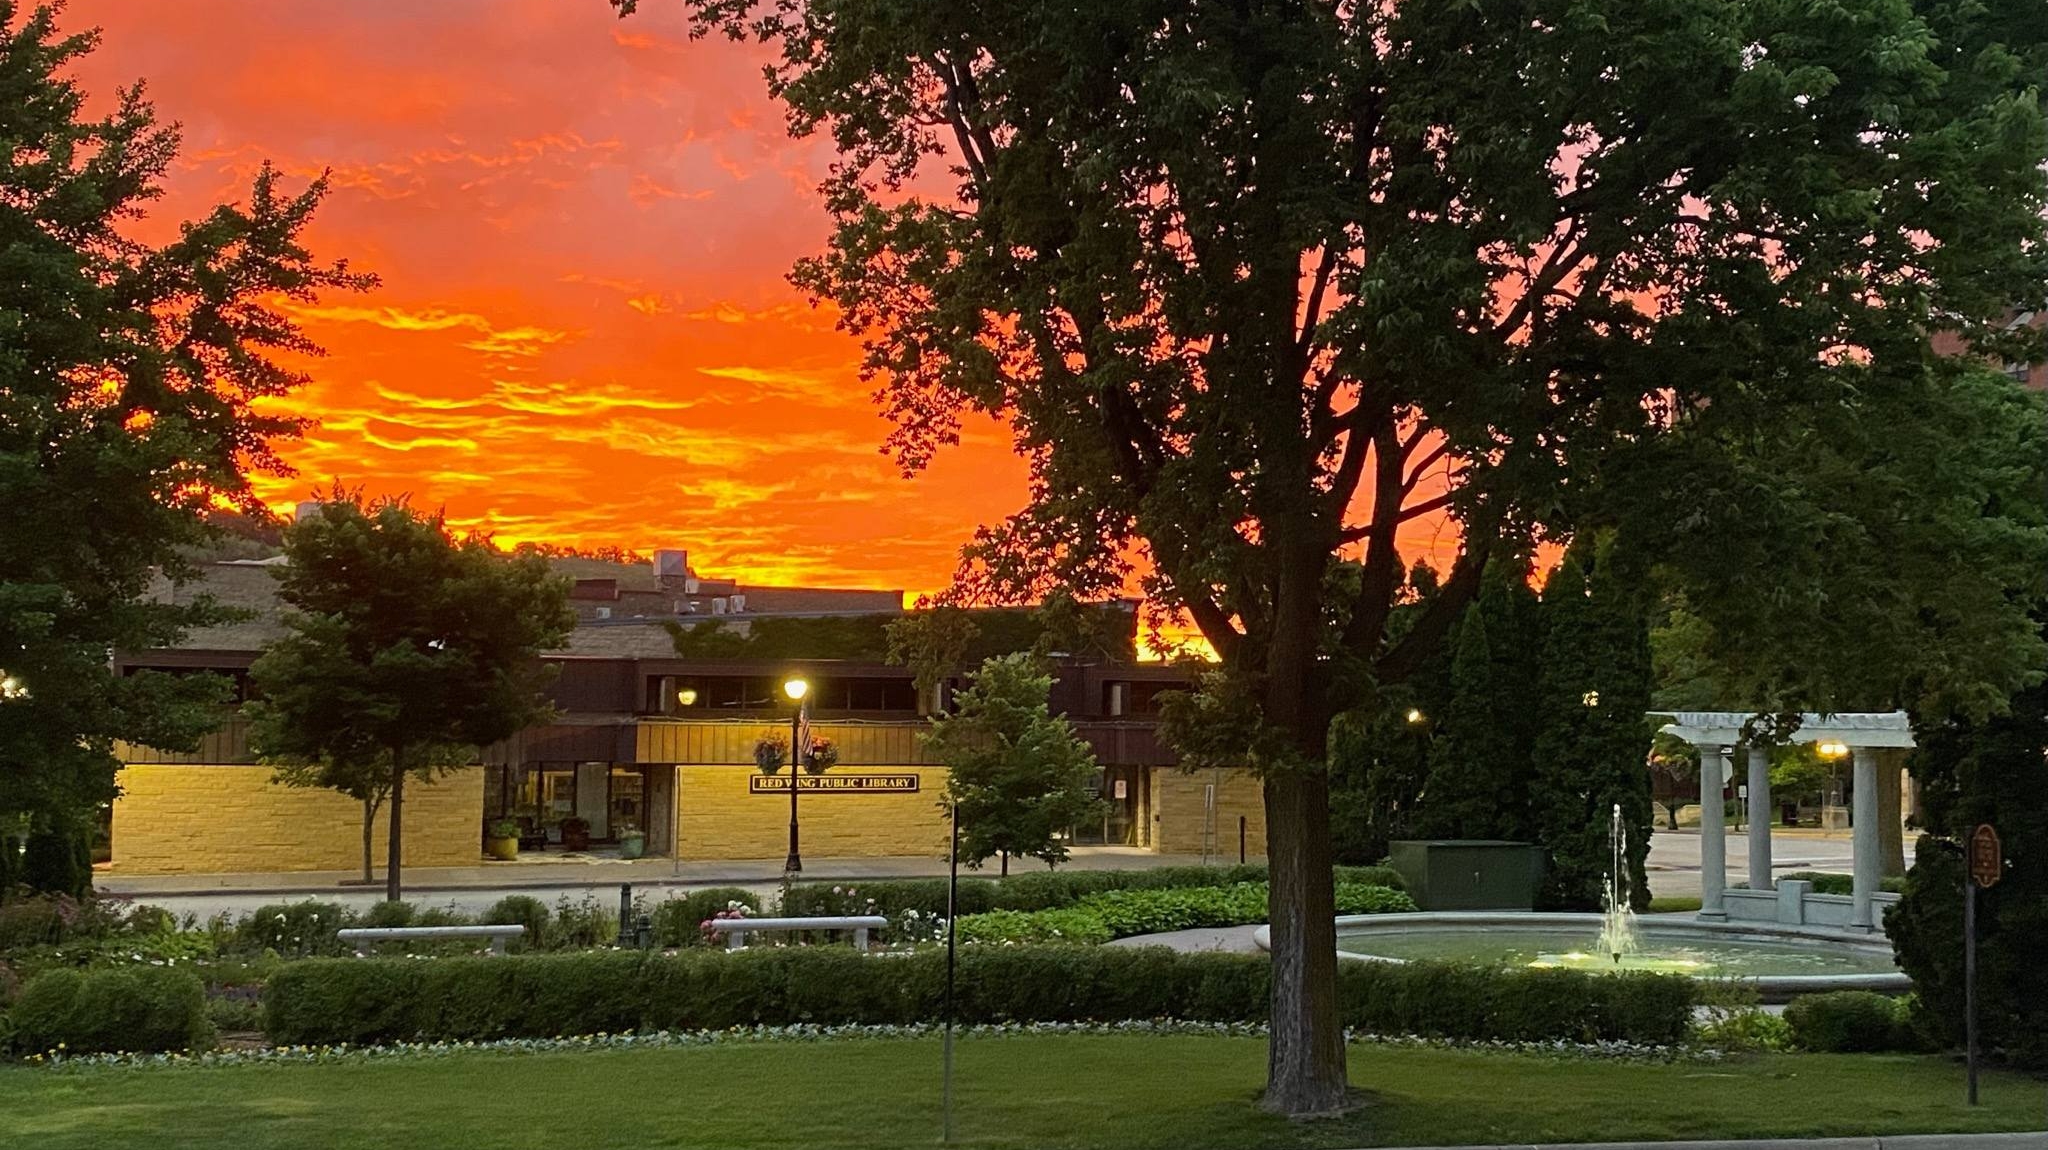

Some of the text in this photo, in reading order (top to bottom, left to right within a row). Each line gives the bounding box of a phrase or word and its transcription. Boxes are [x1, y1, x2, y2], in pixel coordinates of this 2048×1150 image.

[759, 778, 911, 788] RED WING PUBLIC LIBRARY
